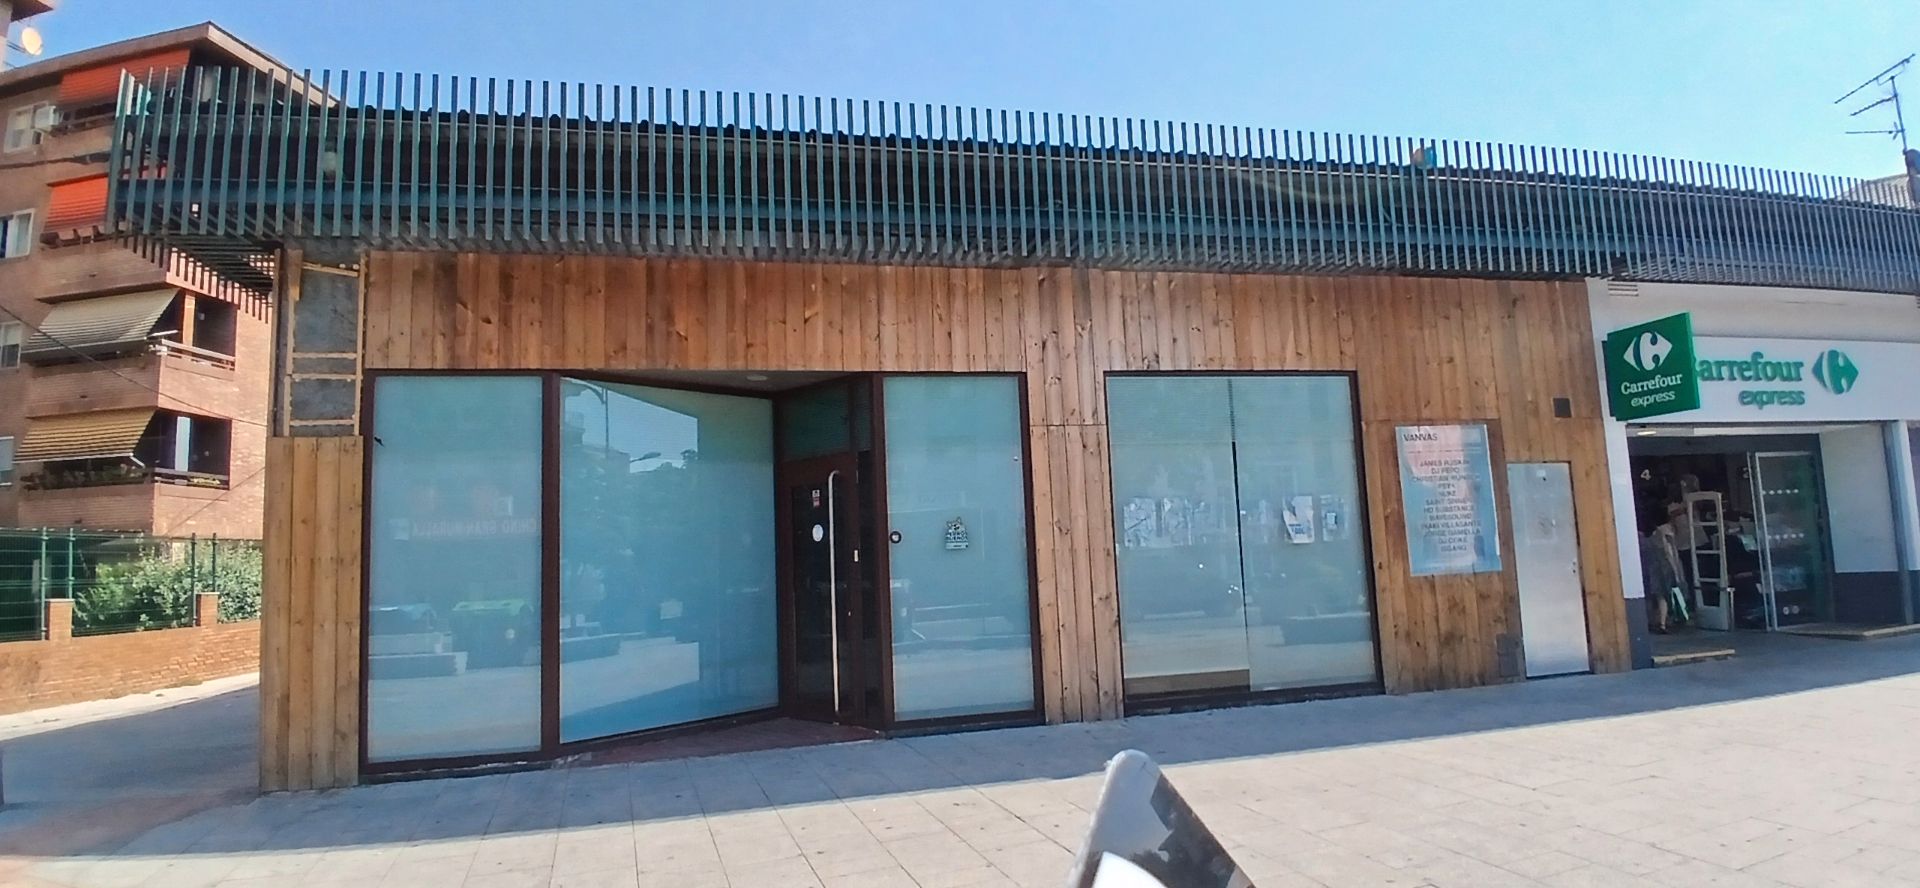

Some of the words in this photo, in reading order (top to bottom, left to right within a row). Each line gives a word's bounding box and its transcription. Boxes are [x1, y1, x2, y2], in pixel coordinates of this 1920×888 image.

[1699, 351, 1804, 382] arrefour
[1621, 373, 1683, 394] Carrefour
[1631, 390, 1676, 408] express
[1738, 390, 1806, 410] express
[1403, 433, 1438, 441] VANVAS
[1640, 468, 1652, 481] 4
